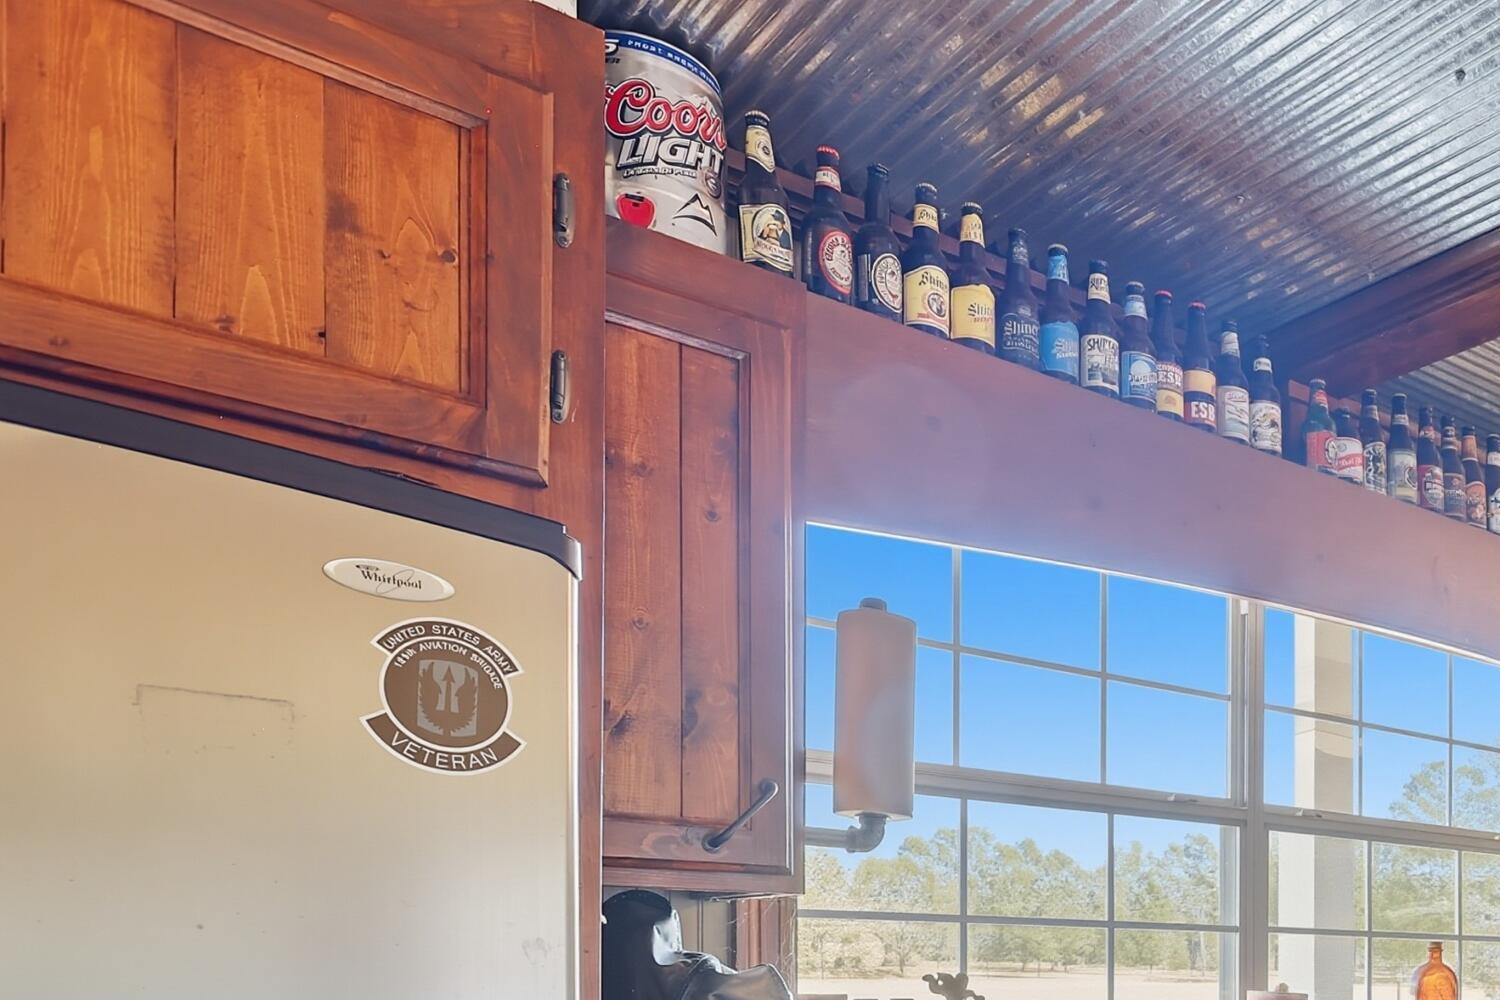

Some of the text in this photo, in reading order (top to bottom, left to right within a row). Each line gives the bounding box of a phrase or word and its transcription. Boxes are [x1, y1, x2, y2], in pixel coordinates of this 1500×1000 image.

[616, 134, 724, 175] LIGHT
[1003, 319, 1040, 337] Shine
[1191, 401, 1215, 421] ESB
[360, 569, 422, 590] Whirlpool
[383, 624, 514, 674] UNITED STATES ARMY
[418, 640, 468, 656] AVIATION
[469, 652, 504, 690] BRIGADE
[391, 730, 499, 770] VETERAN
